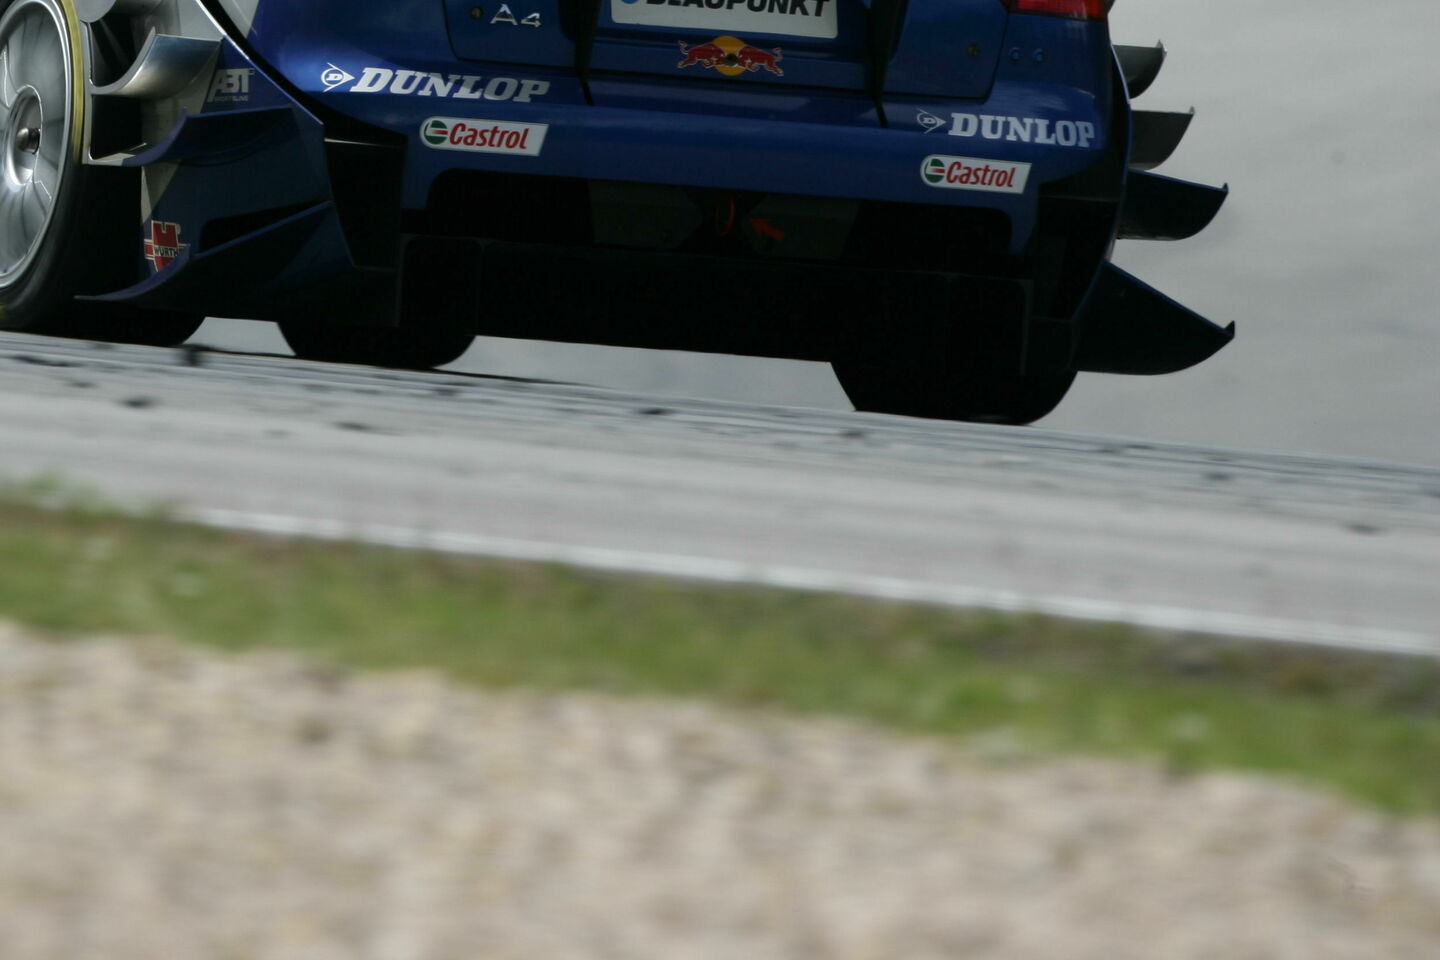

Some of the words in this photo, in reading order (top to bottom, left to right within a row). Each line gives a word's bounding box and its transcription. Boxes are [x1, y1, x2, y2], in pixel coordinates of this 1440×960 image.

[490, 3, 542, 28] A4
[349, 67, 550, 102] DUNLOP
[449, 123, 530, 149] Castrol
[948, 112, 1095, 148] DUNLOP
[946, 161, 1016, 187] Castrol
